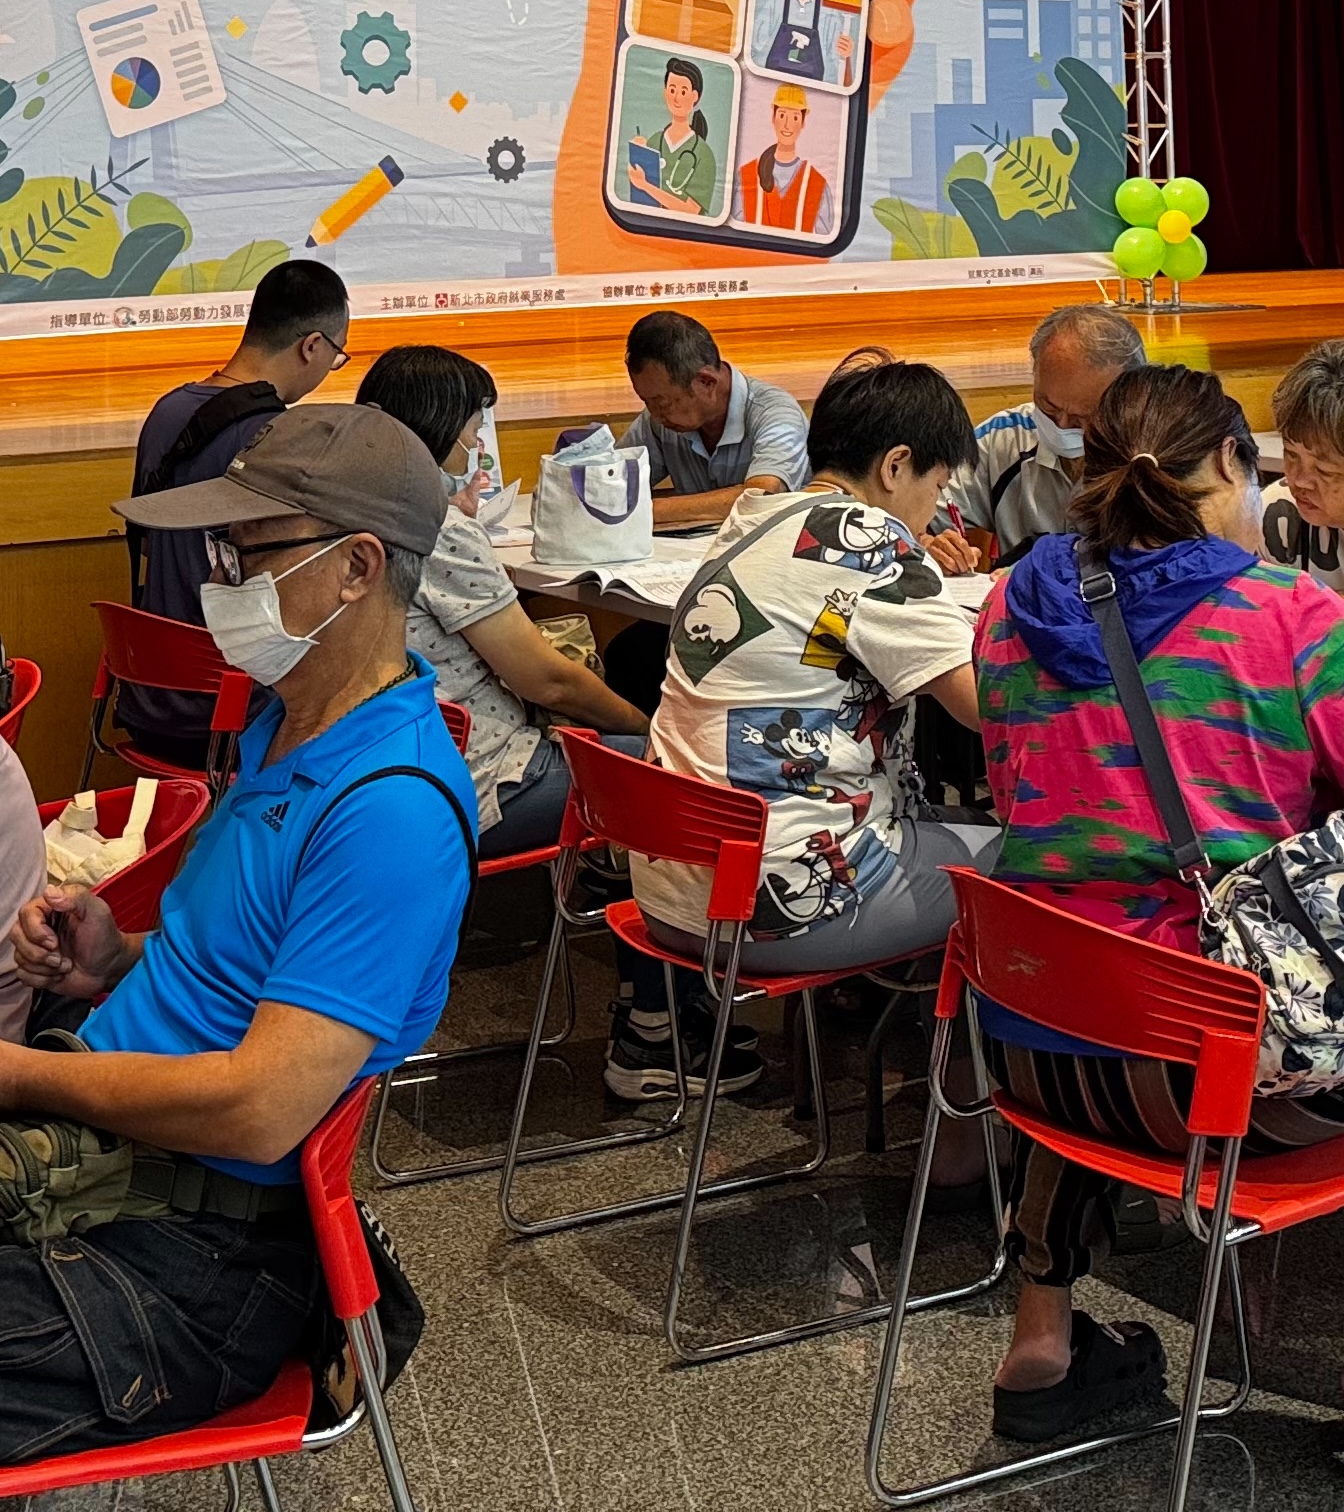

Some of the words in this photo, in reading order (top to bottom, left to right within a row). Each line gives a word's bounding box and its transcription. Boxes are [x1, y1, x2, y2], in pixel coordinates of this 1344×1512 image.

[138, 303, 251, 324] 勞動部勞動力發展
